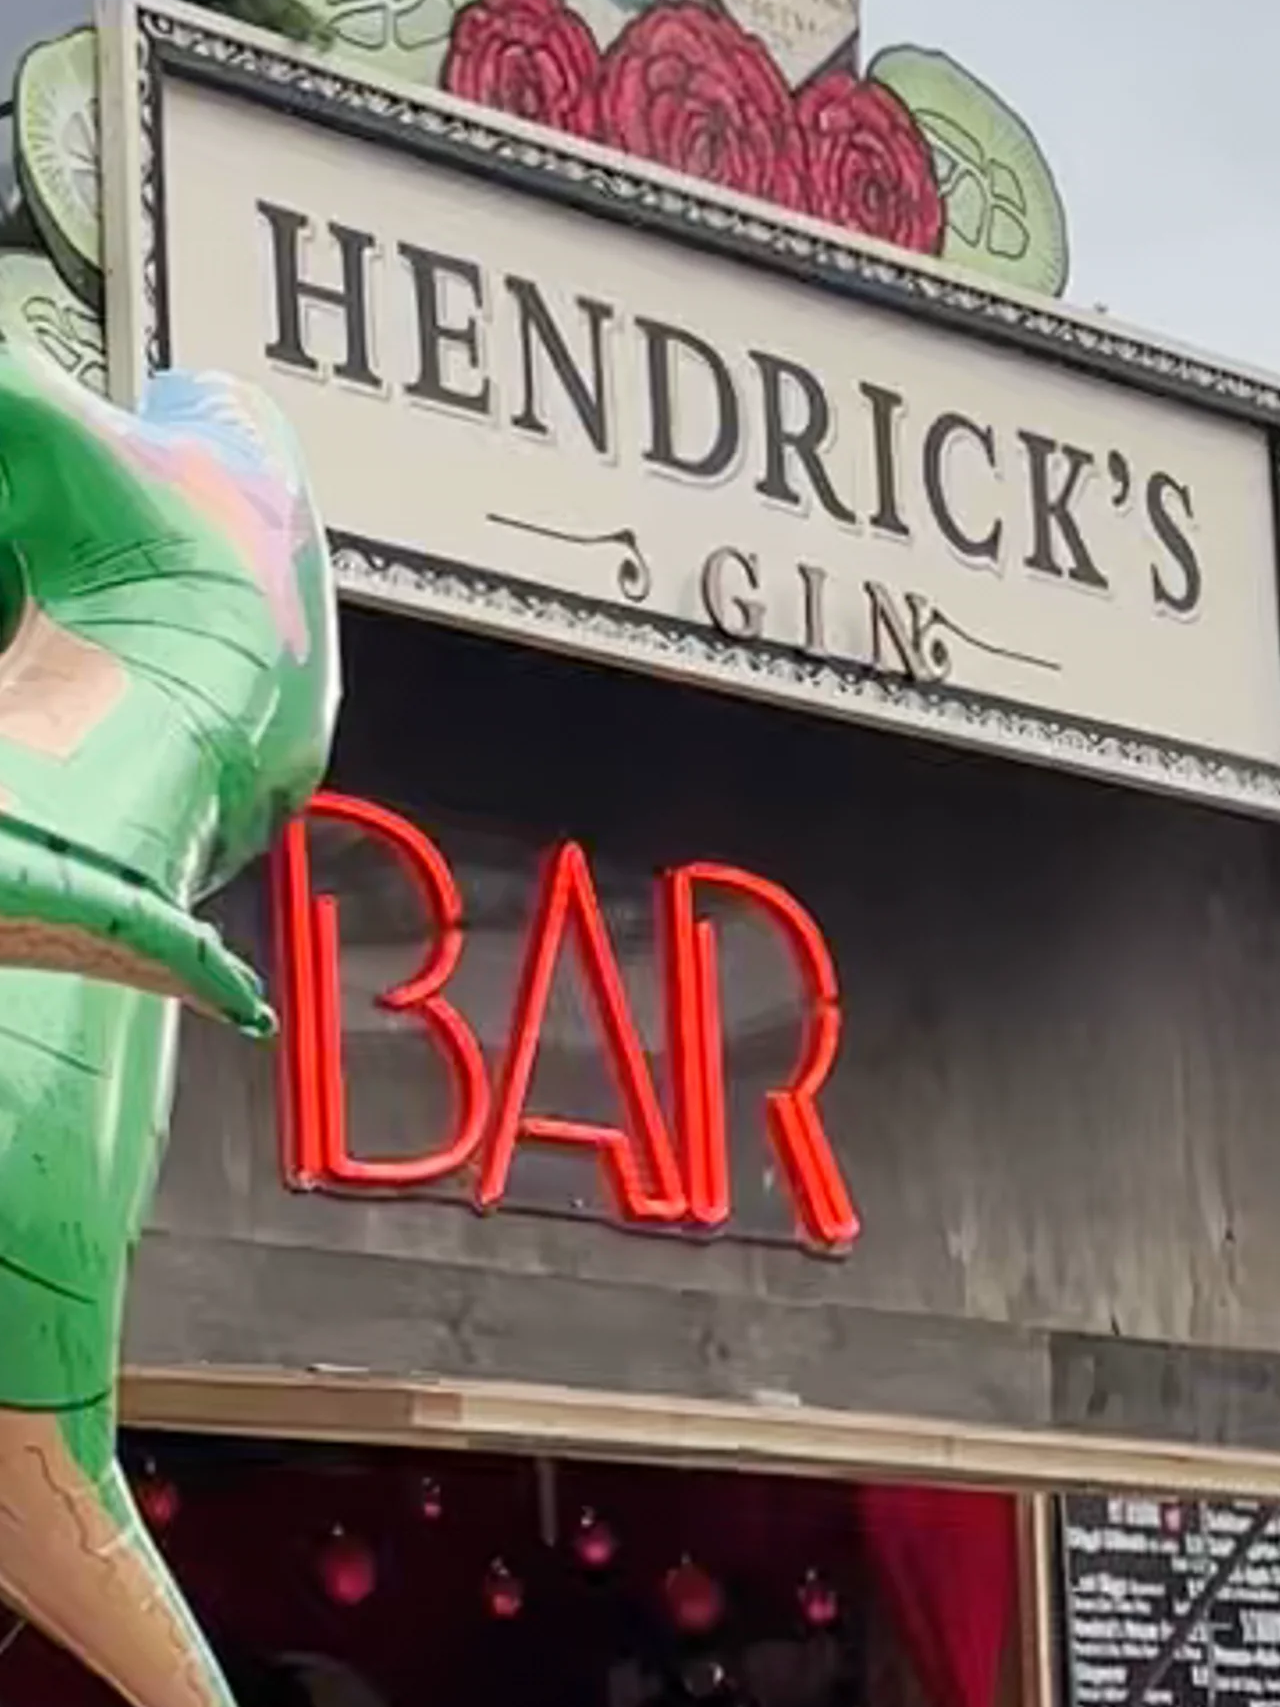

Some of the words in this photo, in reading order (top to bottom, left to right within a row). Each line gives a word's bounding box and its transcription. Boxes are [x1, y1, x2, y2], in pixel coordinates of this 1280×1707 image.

[255, 198, 1203, 615] HENDRICK'S
[699, 545, 926, 682] GIN
[275, 789, 860, 1245] BAR
